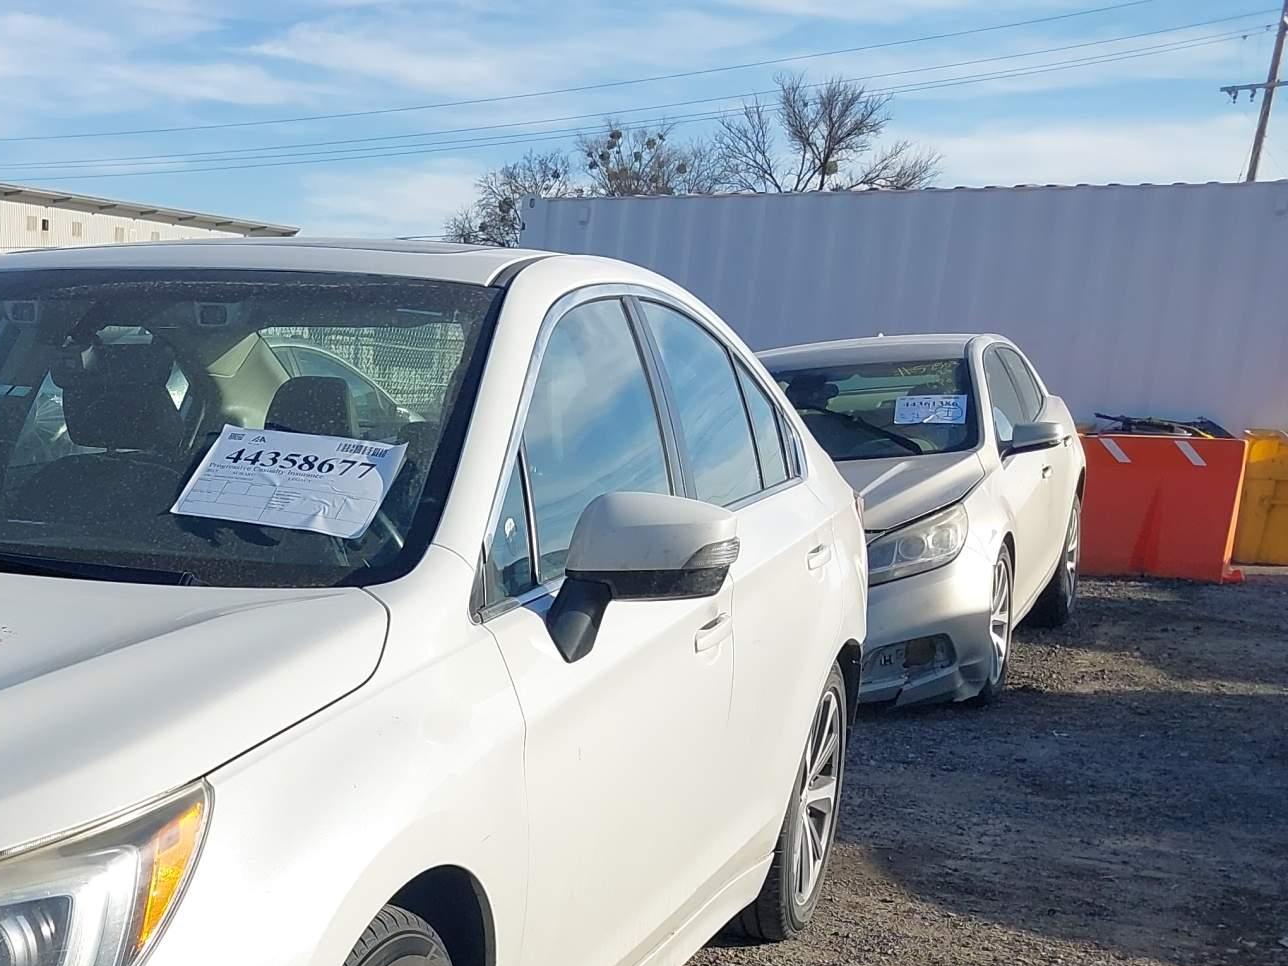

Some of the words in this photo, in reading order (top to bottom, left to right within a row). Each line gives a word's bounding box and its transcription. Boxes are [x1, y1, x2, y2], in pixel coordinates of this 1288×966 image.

[209, 462, 252, 471] Progressive
[253, 466, 285, 476] Casualty
[287, 469, 325, 479] Insurance
[225, 448, 377, 480] 44358677
